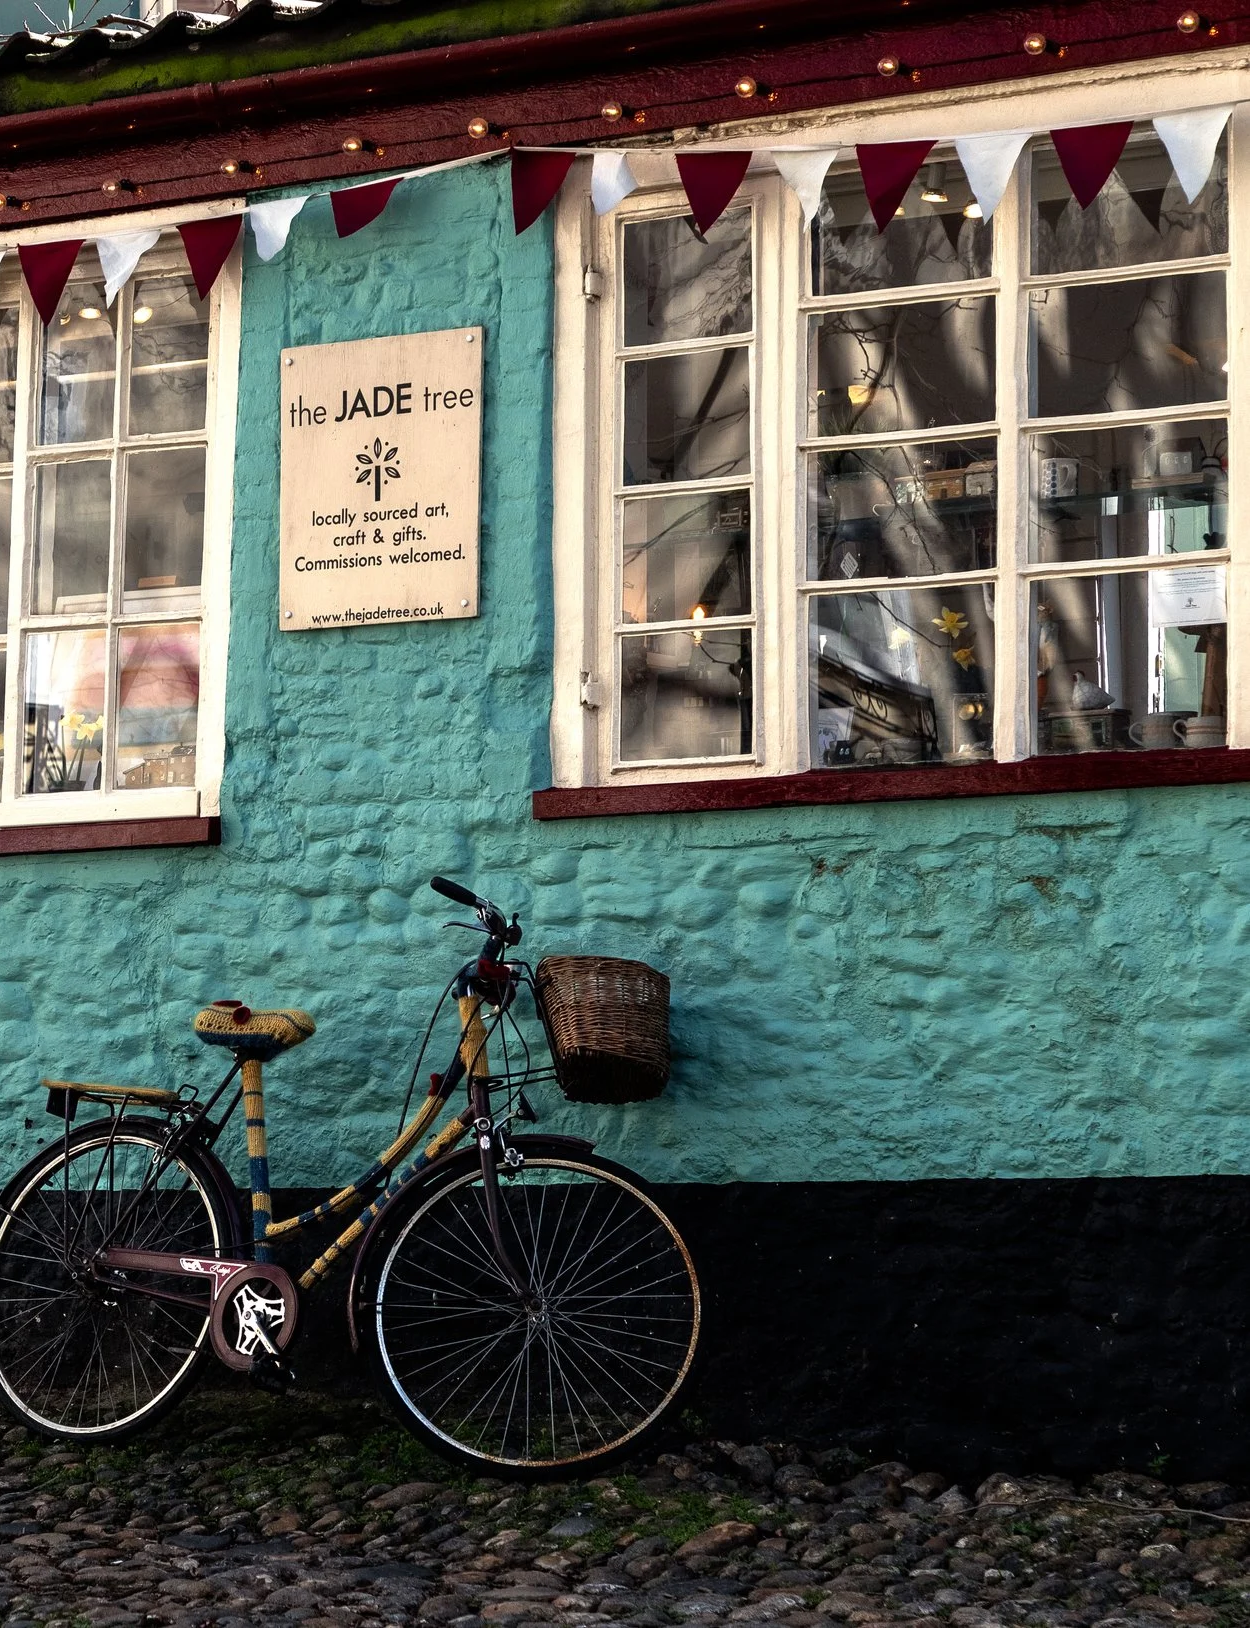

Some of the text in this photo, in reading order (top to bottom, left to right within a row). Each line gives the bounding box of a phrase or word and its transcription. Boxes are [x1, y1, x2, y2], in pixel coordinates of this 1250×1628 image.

[289, 382, 474, 428] the JADE tree
[312, 502, 449, 527] locally sourced art,
[333, 525, 427, 547] craft & gifts.
[294, 543, 466, 573] Commissions welcomed.
[311, 602, 444, 624] www.thejadetree.co.uk
